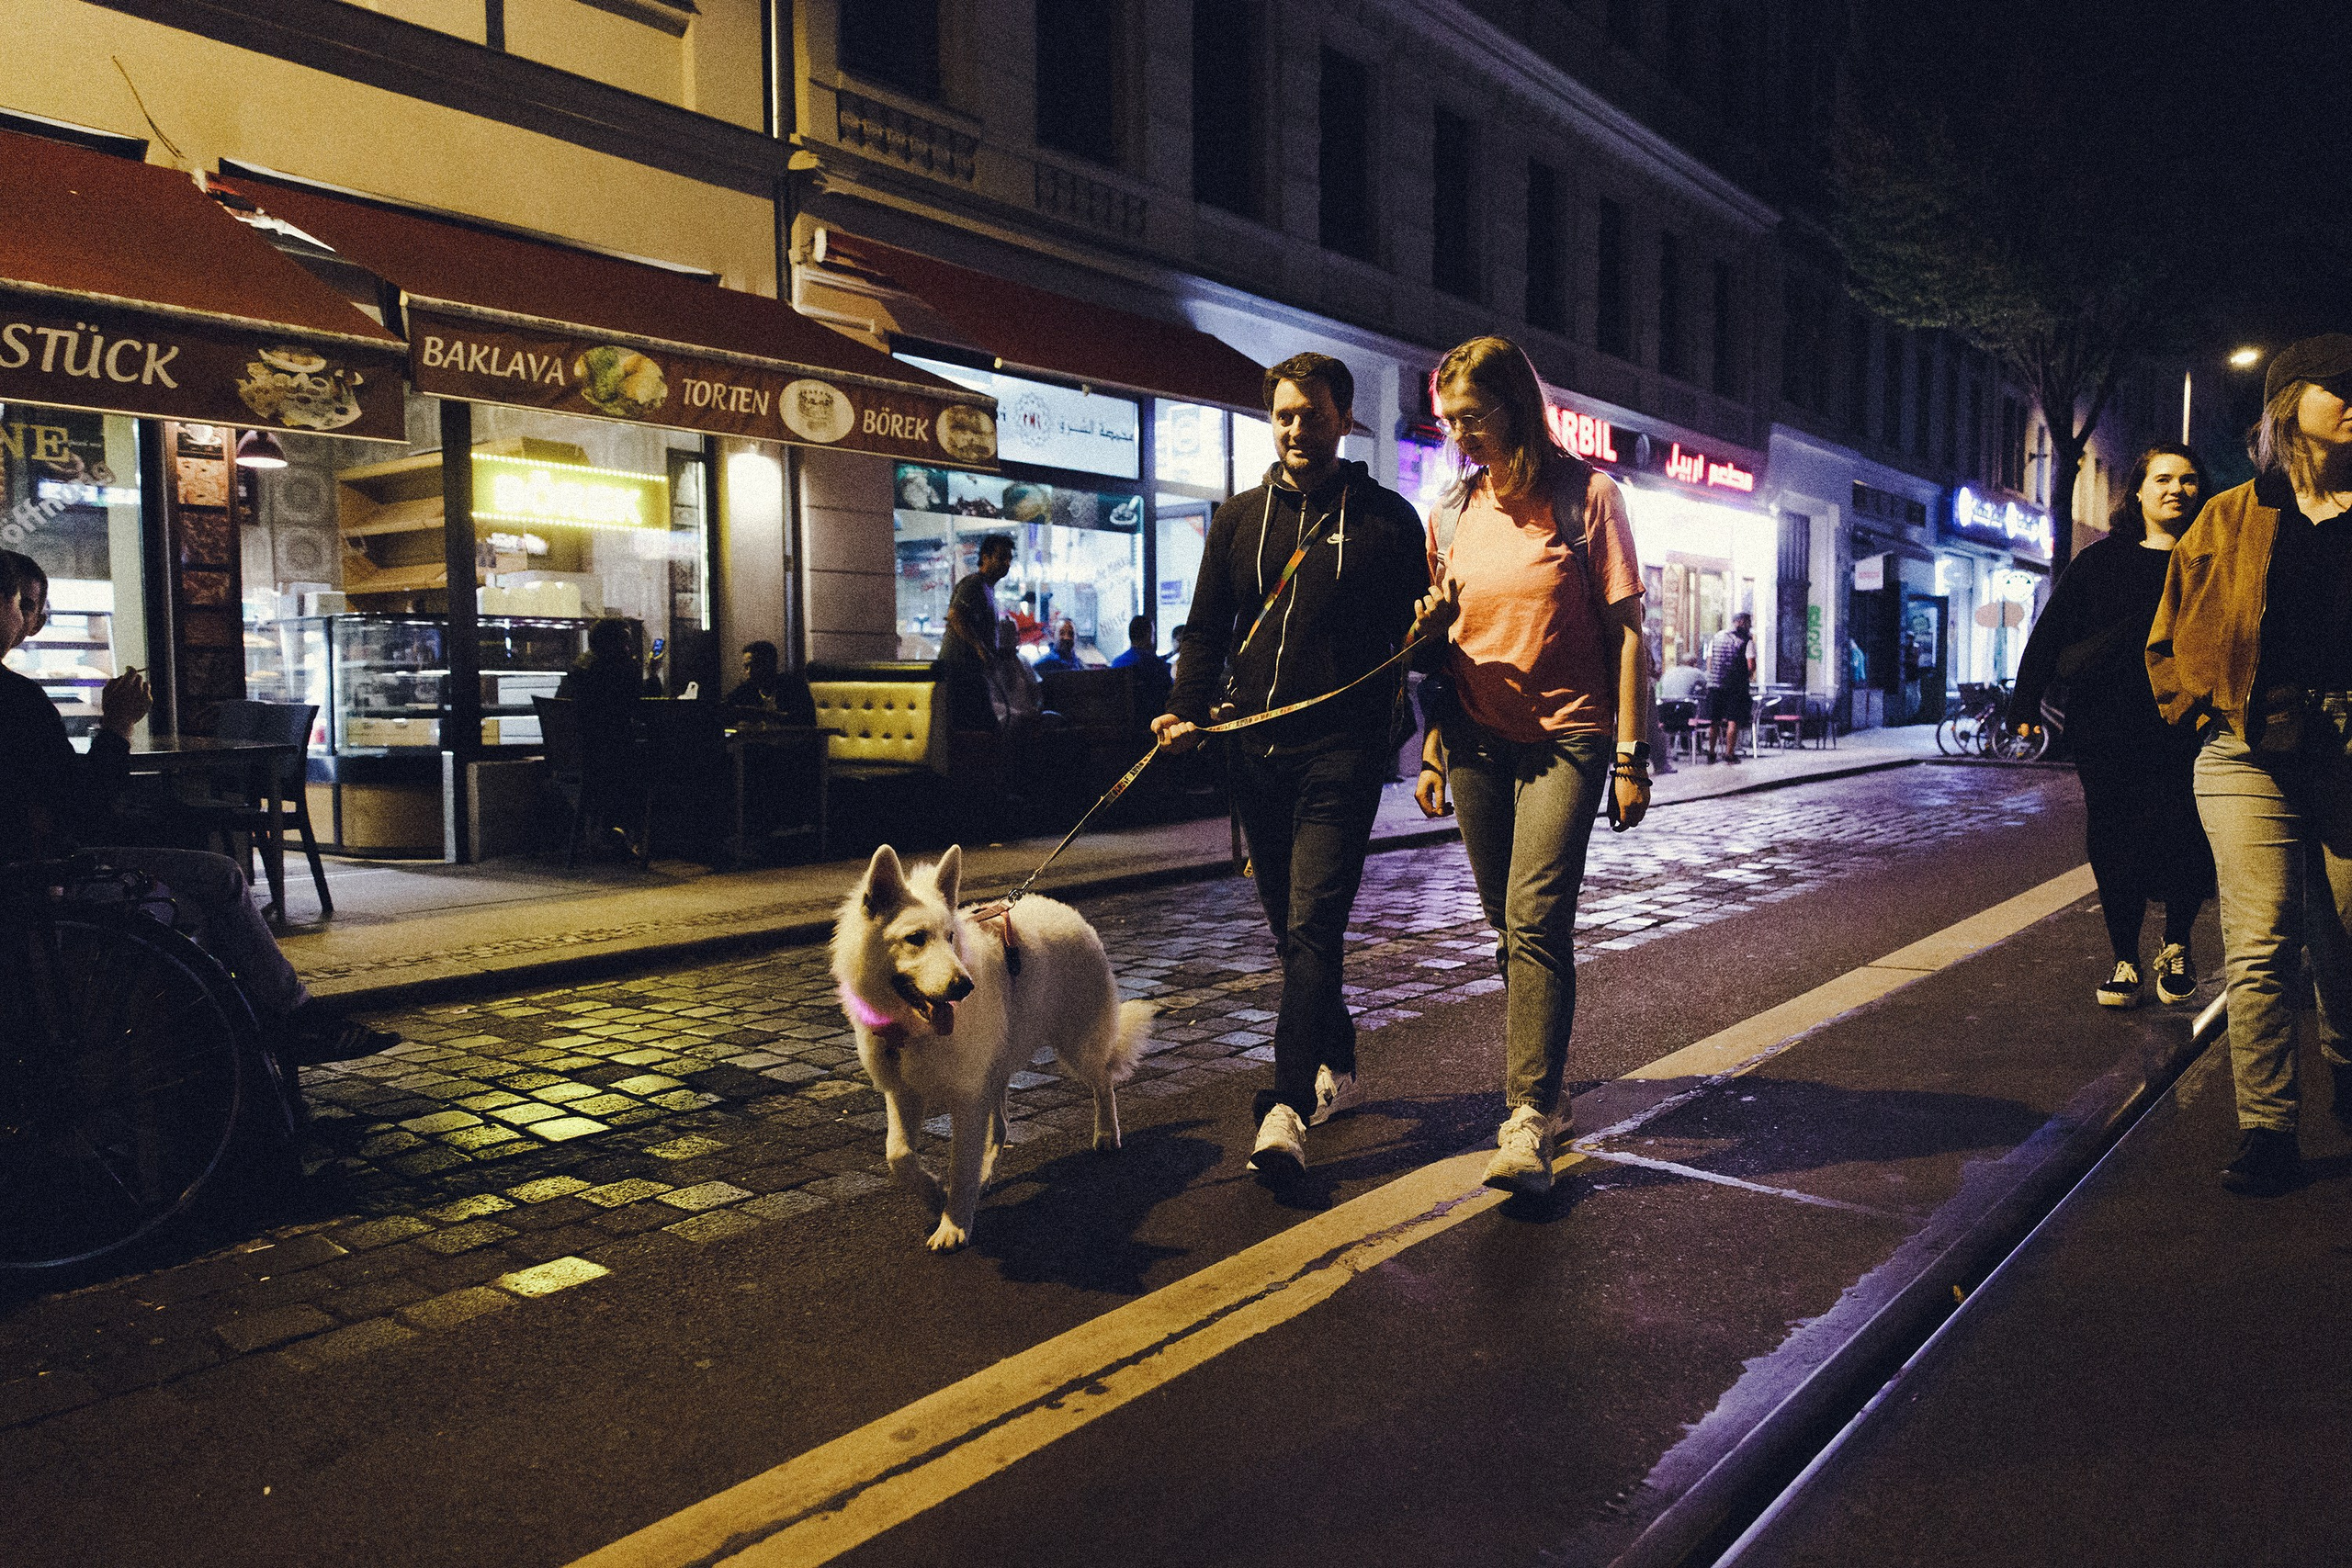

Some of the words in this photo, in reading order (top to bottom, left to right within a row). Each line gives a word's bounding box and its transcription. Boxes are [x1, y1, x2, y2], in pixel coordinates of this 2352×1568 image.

[0, 321, 180, 389] STÜCK
[423, 335, 566, 386] BAKLAVA
[683, 378, 770, 415] TORTEN
[863, 407, 929, 442] BÖREK
